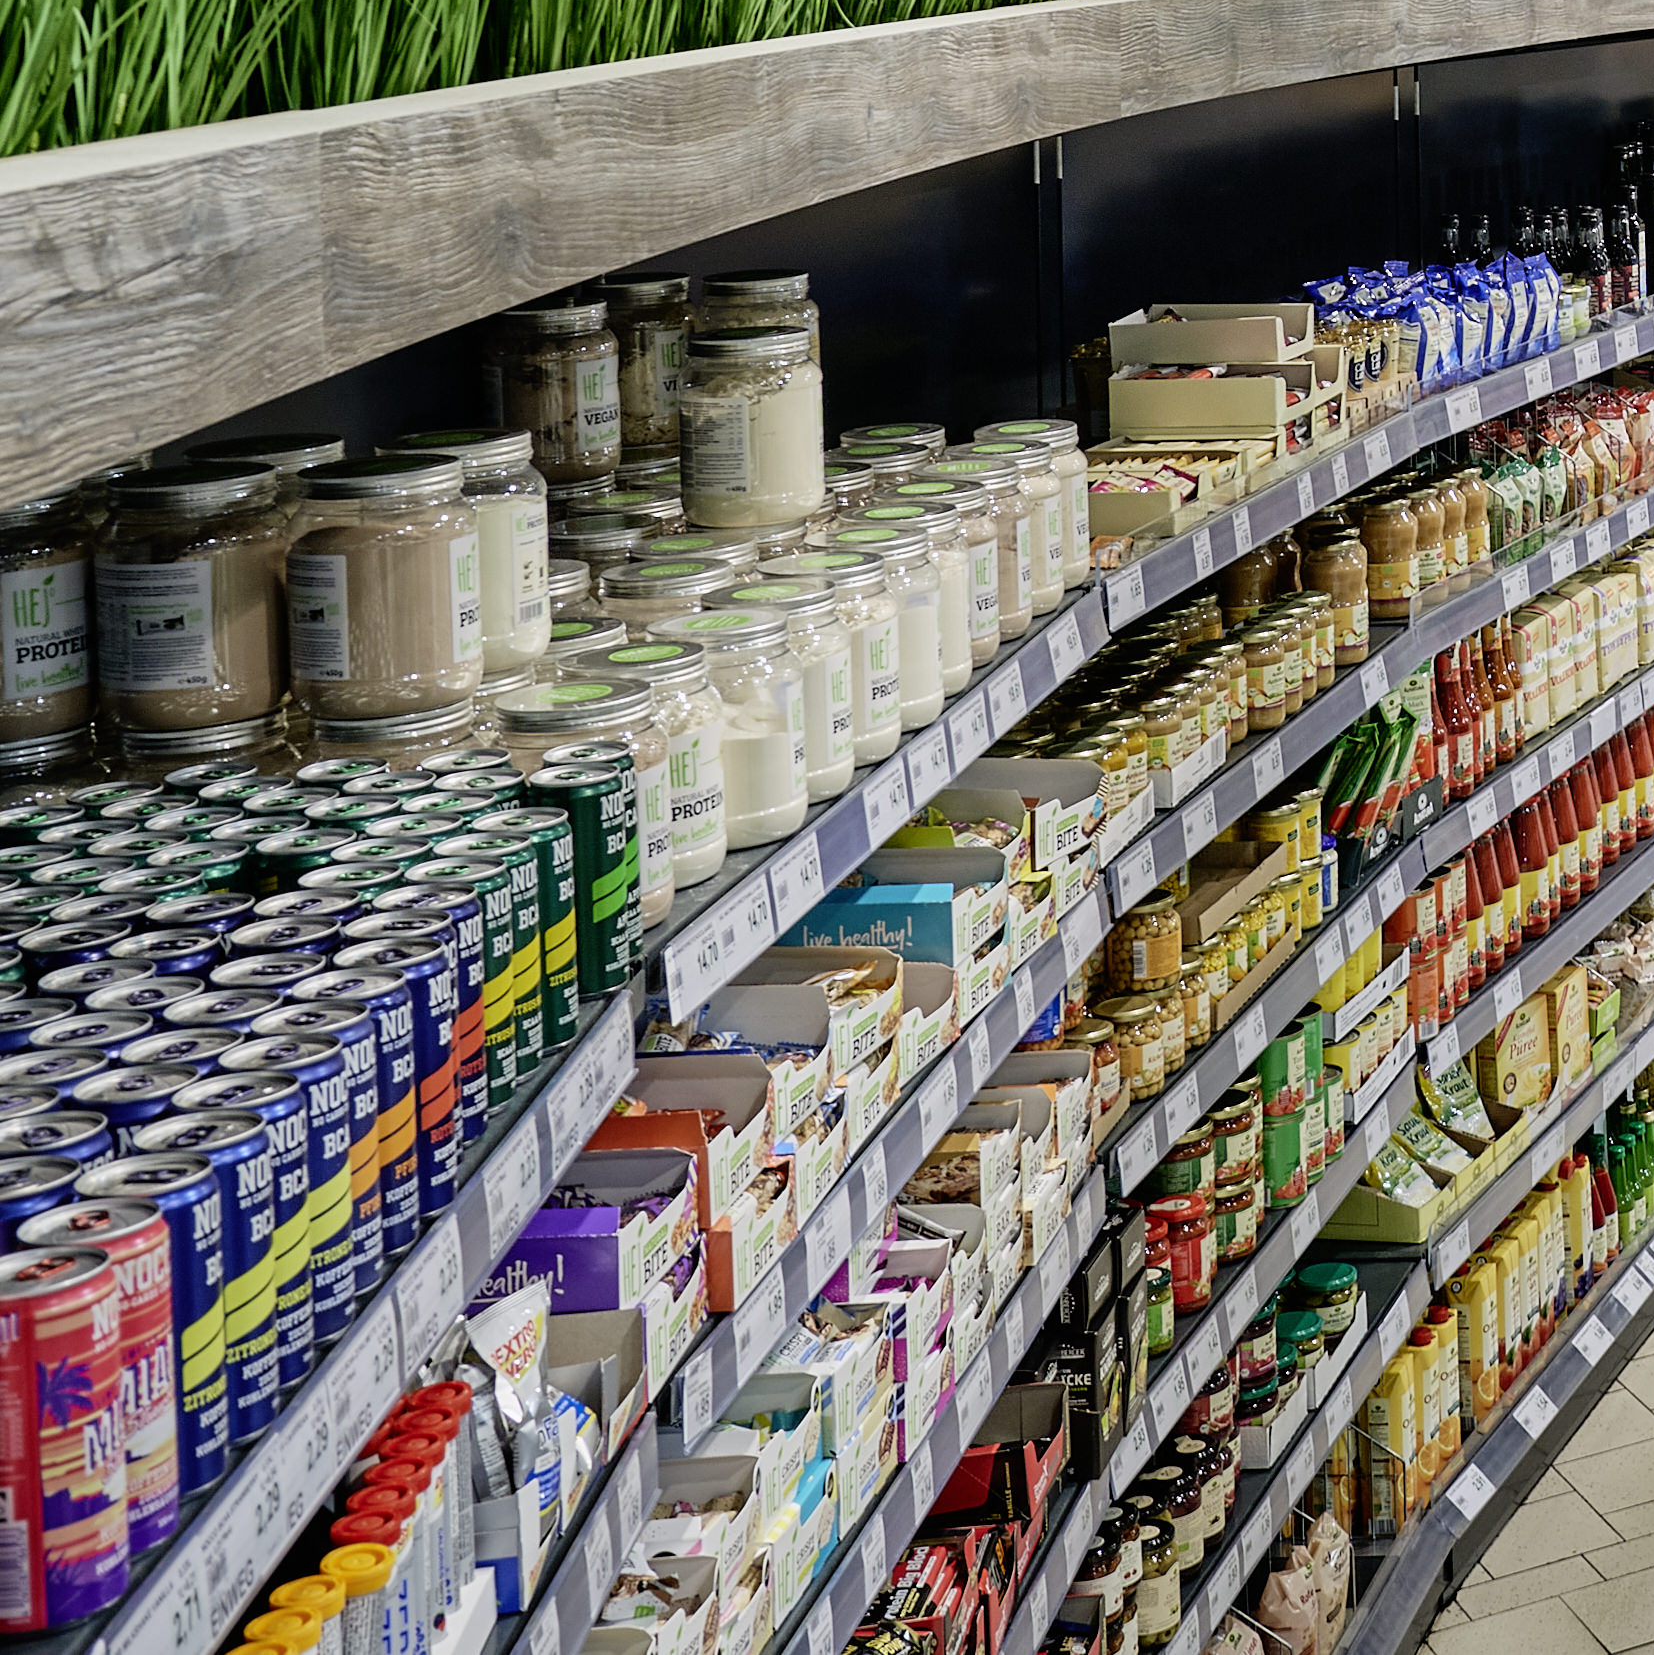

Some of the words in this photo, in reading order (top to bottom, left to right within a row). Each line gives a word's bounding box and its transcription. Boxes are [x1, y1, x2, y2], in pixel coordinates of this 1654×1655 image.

[584, 407, 619, 427] VEGAN
[13, 574, 54, 628] HEJ
[16, 635, 88, 664] PROTEI
[870, 628, 891, 671] HEJ
[669, 739, 699, 788] HEJ
[671, 792, 723, 822] PROTEIN
[1056, 825, 1079, 850] BITE
[839, 916, 913, 951] healthy!
[971, 916, 991, 945] BITE
[971, 978, 990, 1009] BITE
[852, 1024, 877, 1060] BITE
[916, 1034, 939, 1068] BITE
[789, 1090, 815, 1125] BITE
[730, 1158, 751, 1196] BITE
[643, 1240, 669, 1285] BITE
[754, 1236, 775, 1276] BITE
[668, 1320, 688, 1363] BITE
